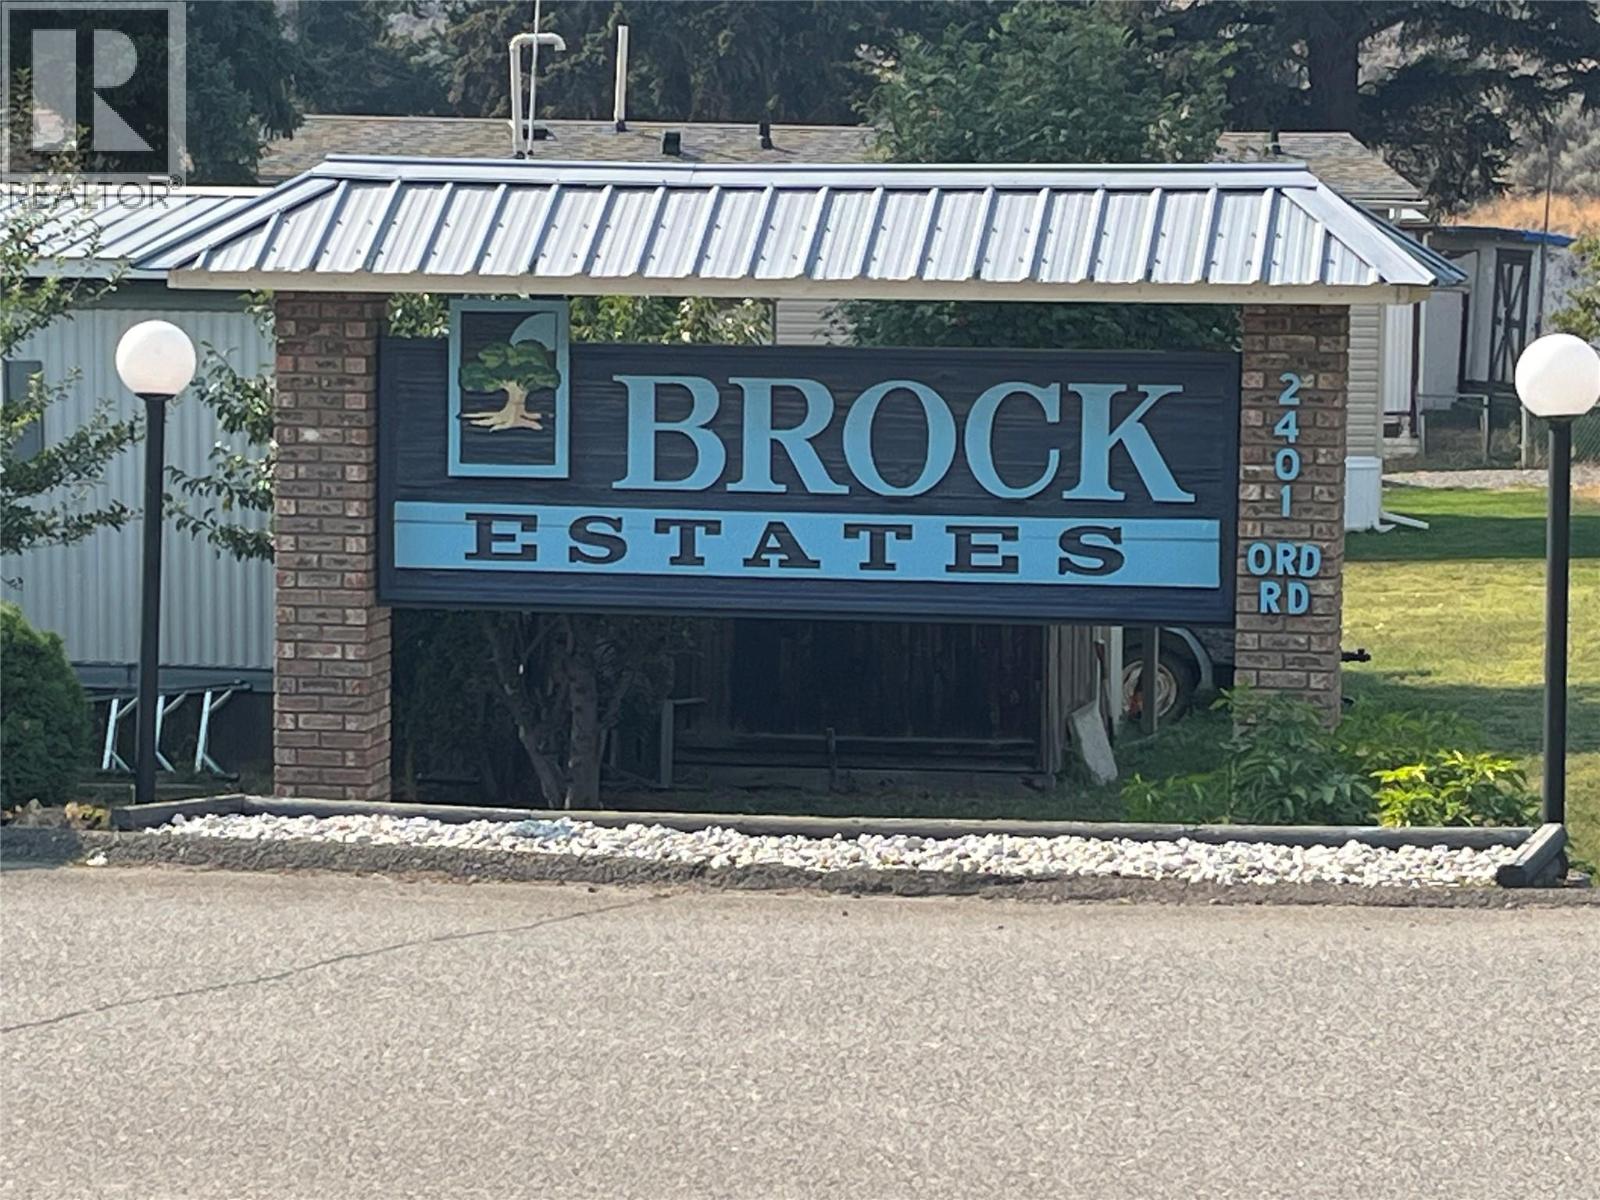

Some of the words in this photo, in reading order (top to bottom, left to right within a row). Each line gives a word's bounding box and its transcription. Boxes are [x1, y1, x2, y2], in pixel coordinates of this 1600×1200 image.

[612, 374, 1195, 504] BROCK
[1273, 372, 1301, 518] 2401
[465, 512, 1126, 576] ESTATES
[1247, 542, 1321, 577] ORD
[1260, 580, 1310, 615] RD
